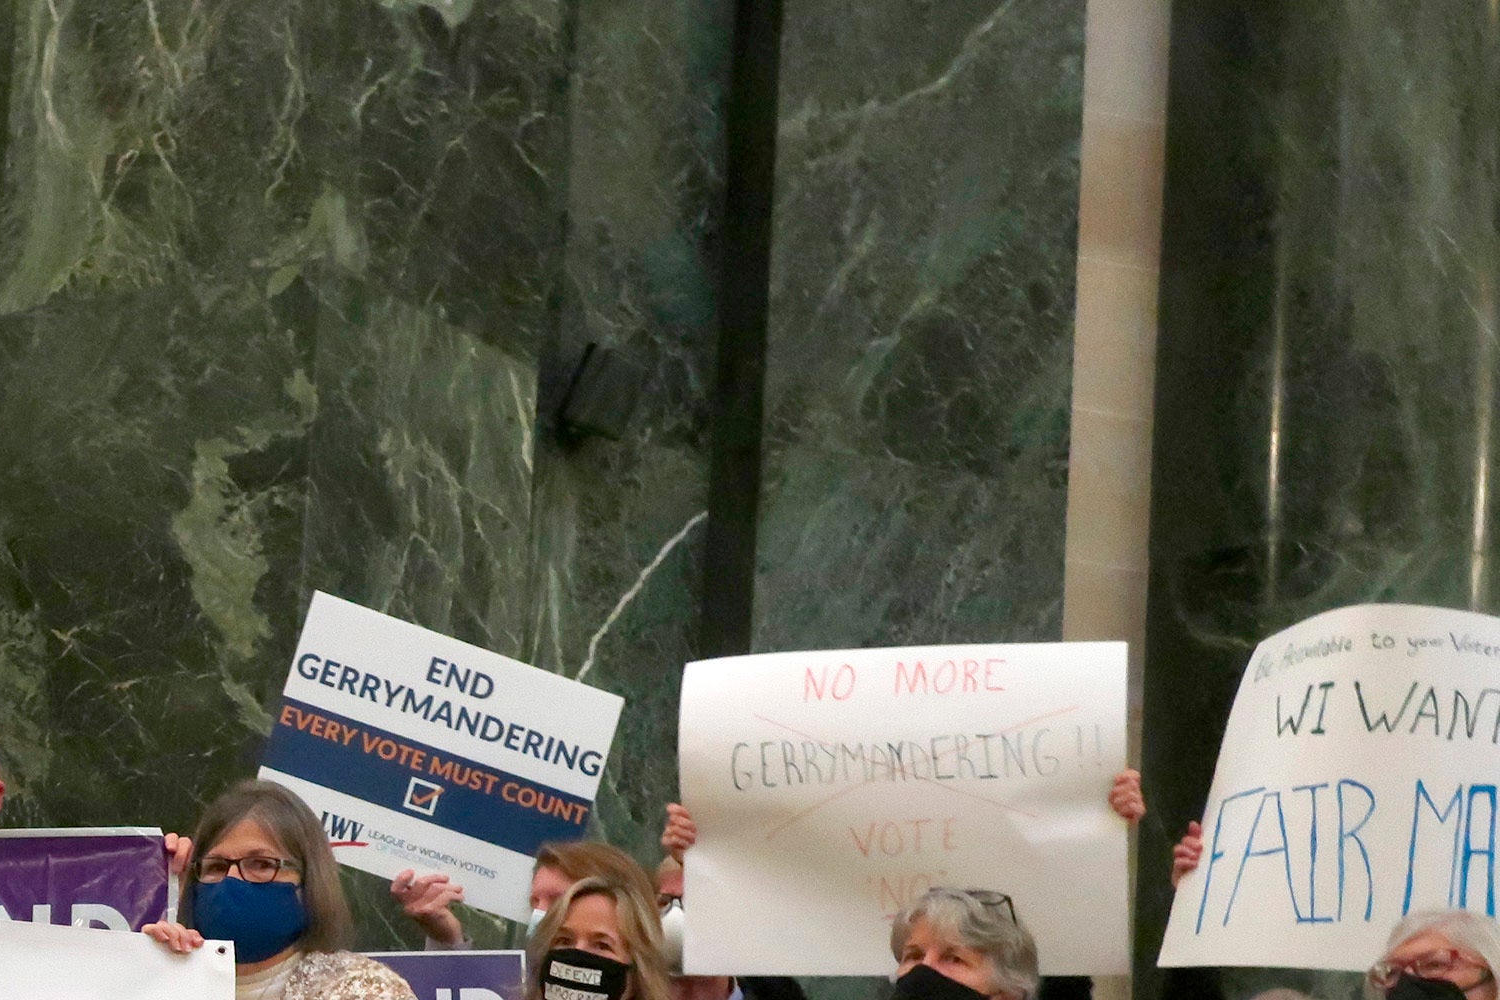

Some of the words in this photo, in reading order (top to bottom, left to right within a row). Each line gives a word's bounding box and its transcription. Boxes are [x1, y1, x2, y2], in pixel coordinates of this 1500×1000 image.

[1370, 632, 1396, 649] to
[426, 656, 495, 700] END
[803, 663, 857, 703] NO
[894, 658, 1007, 694] MORE
[297, 653, 603, 777] GERRYMANDERING
[1277, 681, 1335, 737] WI
[280, 705, 359, 746] EVERY
[362, 732, 425, 772] VOTE
[429, 758, 499, 795] MUST
[501, 781, 589, 826] COUNT
[368, 829, 405, 849] LEAGUE
[420, 847, 457, 866] WOMEN
[850, 817, 960, 858] VOTE
[1196, 778, 1376, 935] FAIR
[1402, 778, 1498, 919] MA
